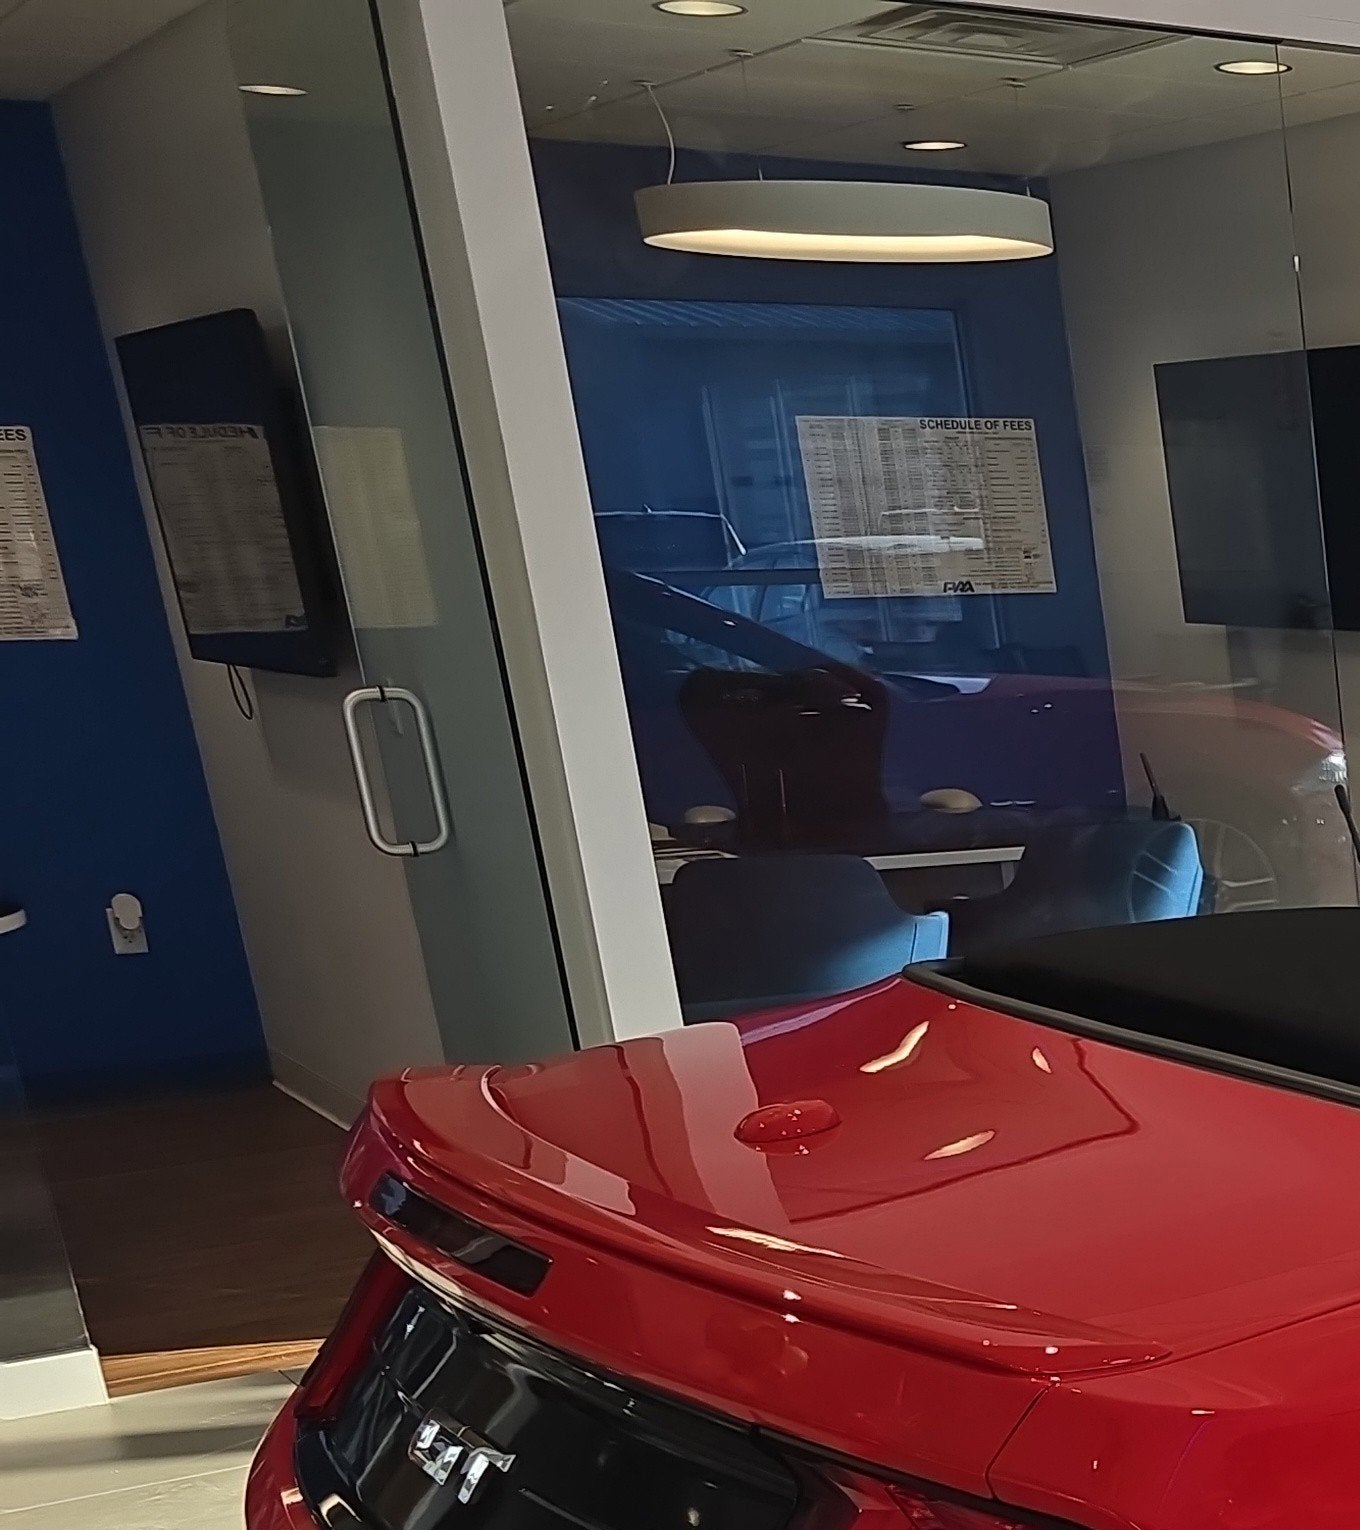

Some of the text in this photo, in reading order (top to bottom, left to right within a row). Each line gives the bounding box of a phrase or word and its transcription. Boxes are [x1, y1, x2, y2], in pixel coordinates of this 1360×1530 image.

[919, 419, 1033, 431] SCHEDULE OF FEES
